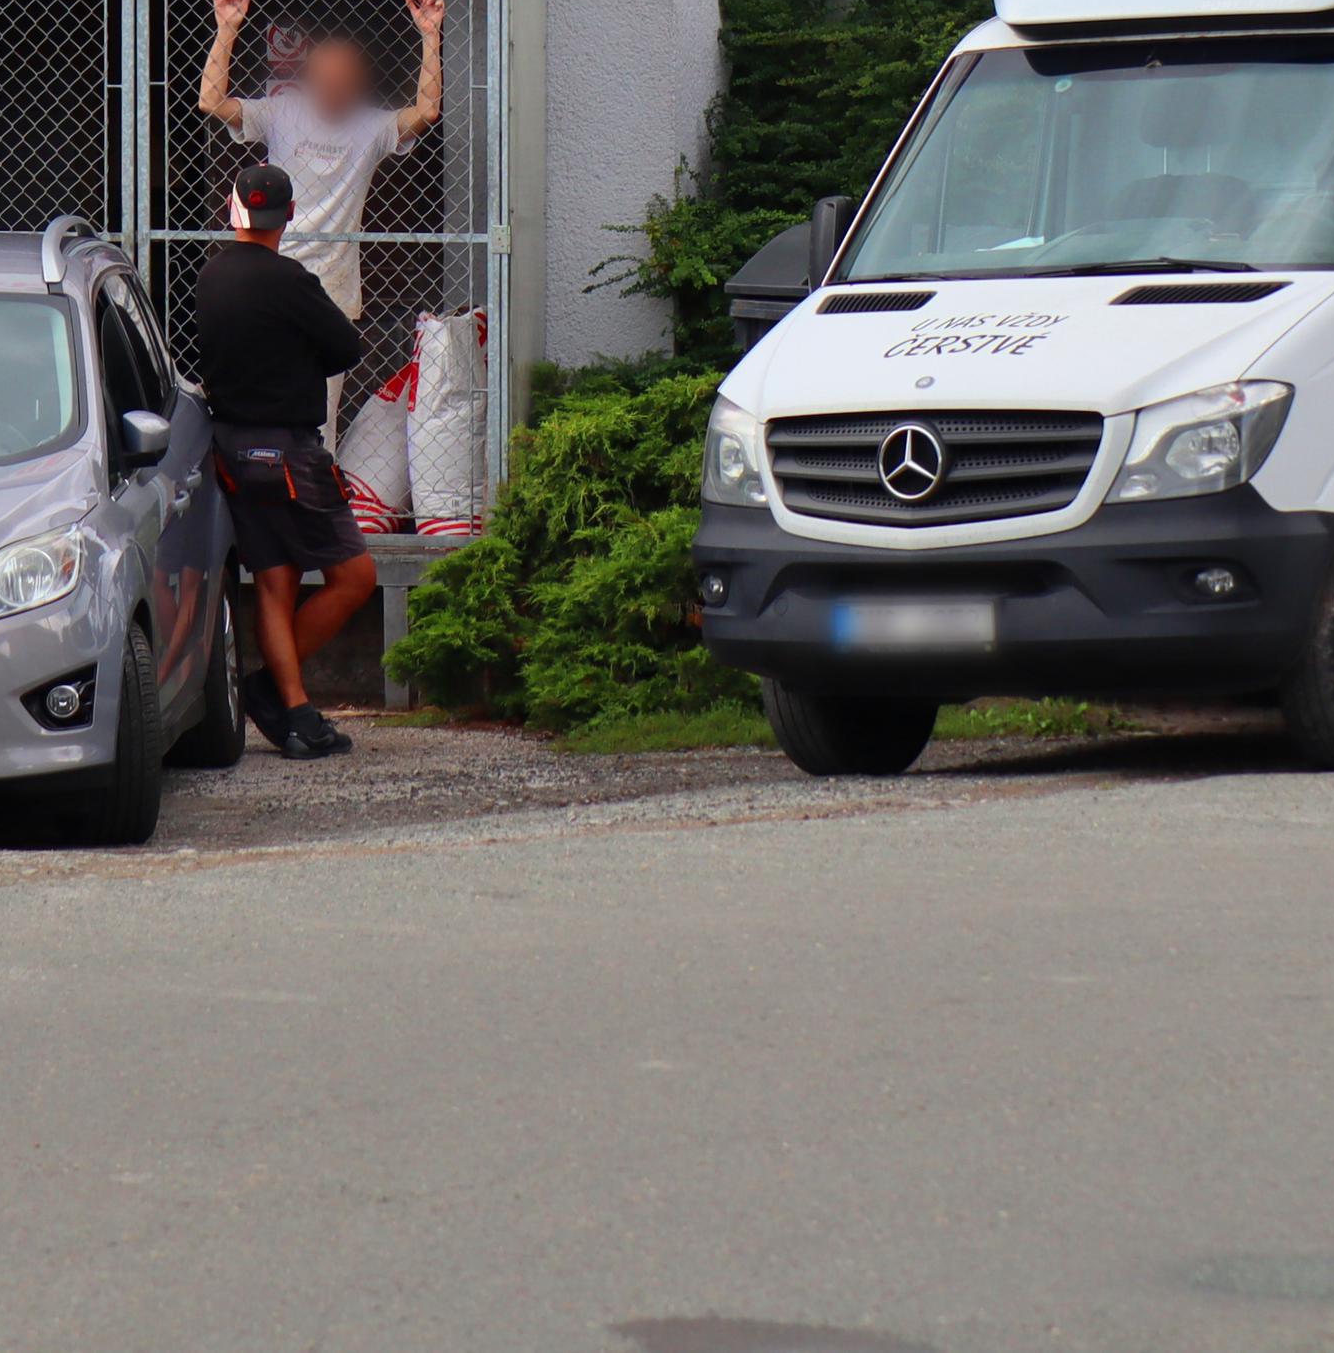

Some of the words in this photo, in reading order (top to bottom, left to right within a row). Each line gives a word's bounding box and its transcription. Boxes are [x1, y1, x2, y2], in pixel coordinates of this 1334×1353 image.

[911, 318, 939, 332] U
[934, 312, 997, 330] NÁS
[995, 312, 1068, 329] VŽDY
[883, 331, 1051, 359] ČERSTVÉ
